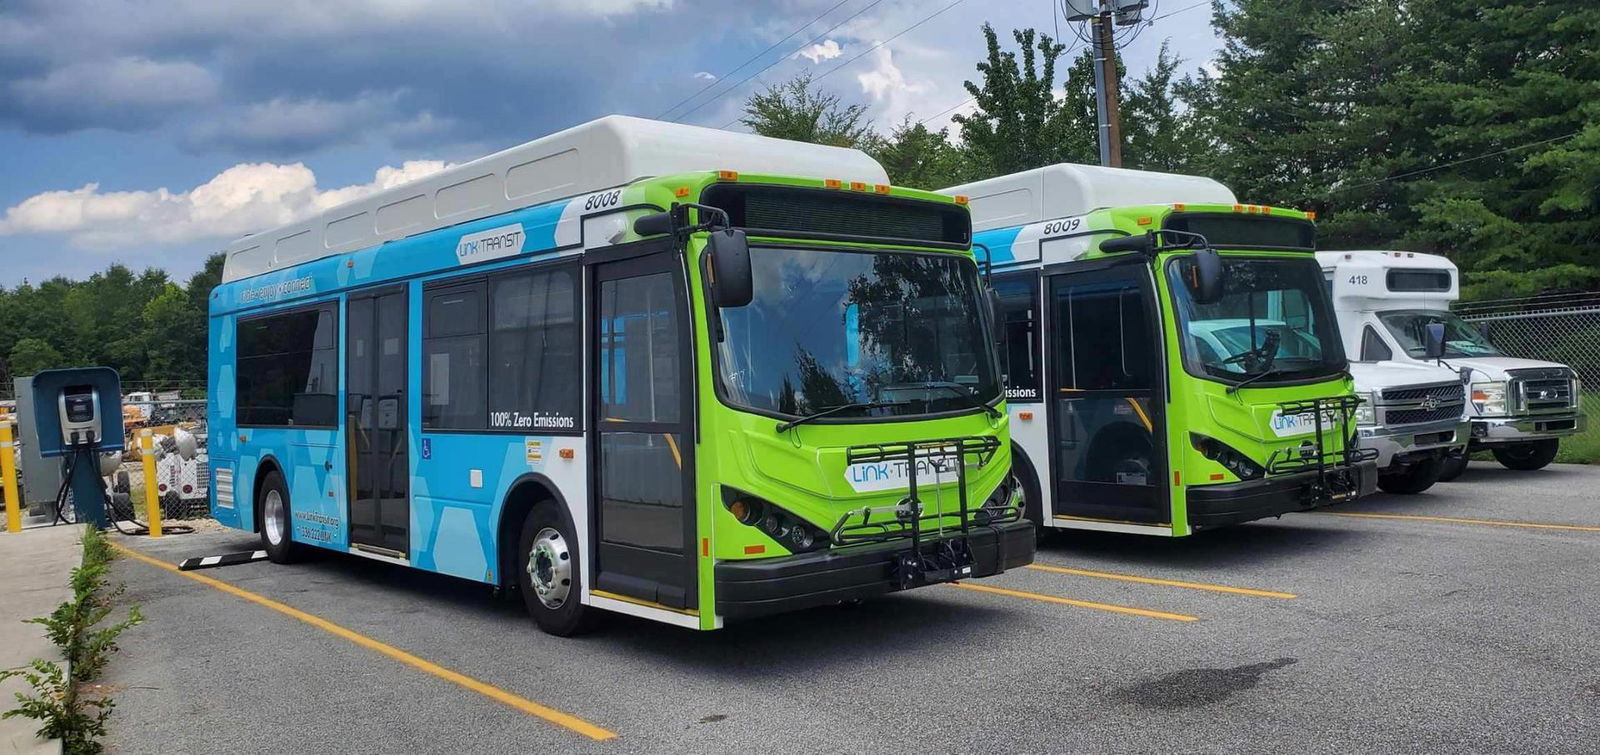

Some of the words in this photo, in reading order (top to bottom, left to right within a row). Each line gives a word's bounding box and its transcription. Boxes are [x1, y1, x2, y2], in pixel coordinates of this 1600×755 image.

[584, 190, 621, 211] 8008
[1043, 218, 1080, 235] 8009
[481, 231, 521, 253] TRANSIT
[1349, 275, 1367, 285] 418
[1004, 385, 1036, 398] issions
[490, 412, 512, 427] 100%
[513, 412, 532, 427] Zero
[533, 412, 574, 428] Emissions
